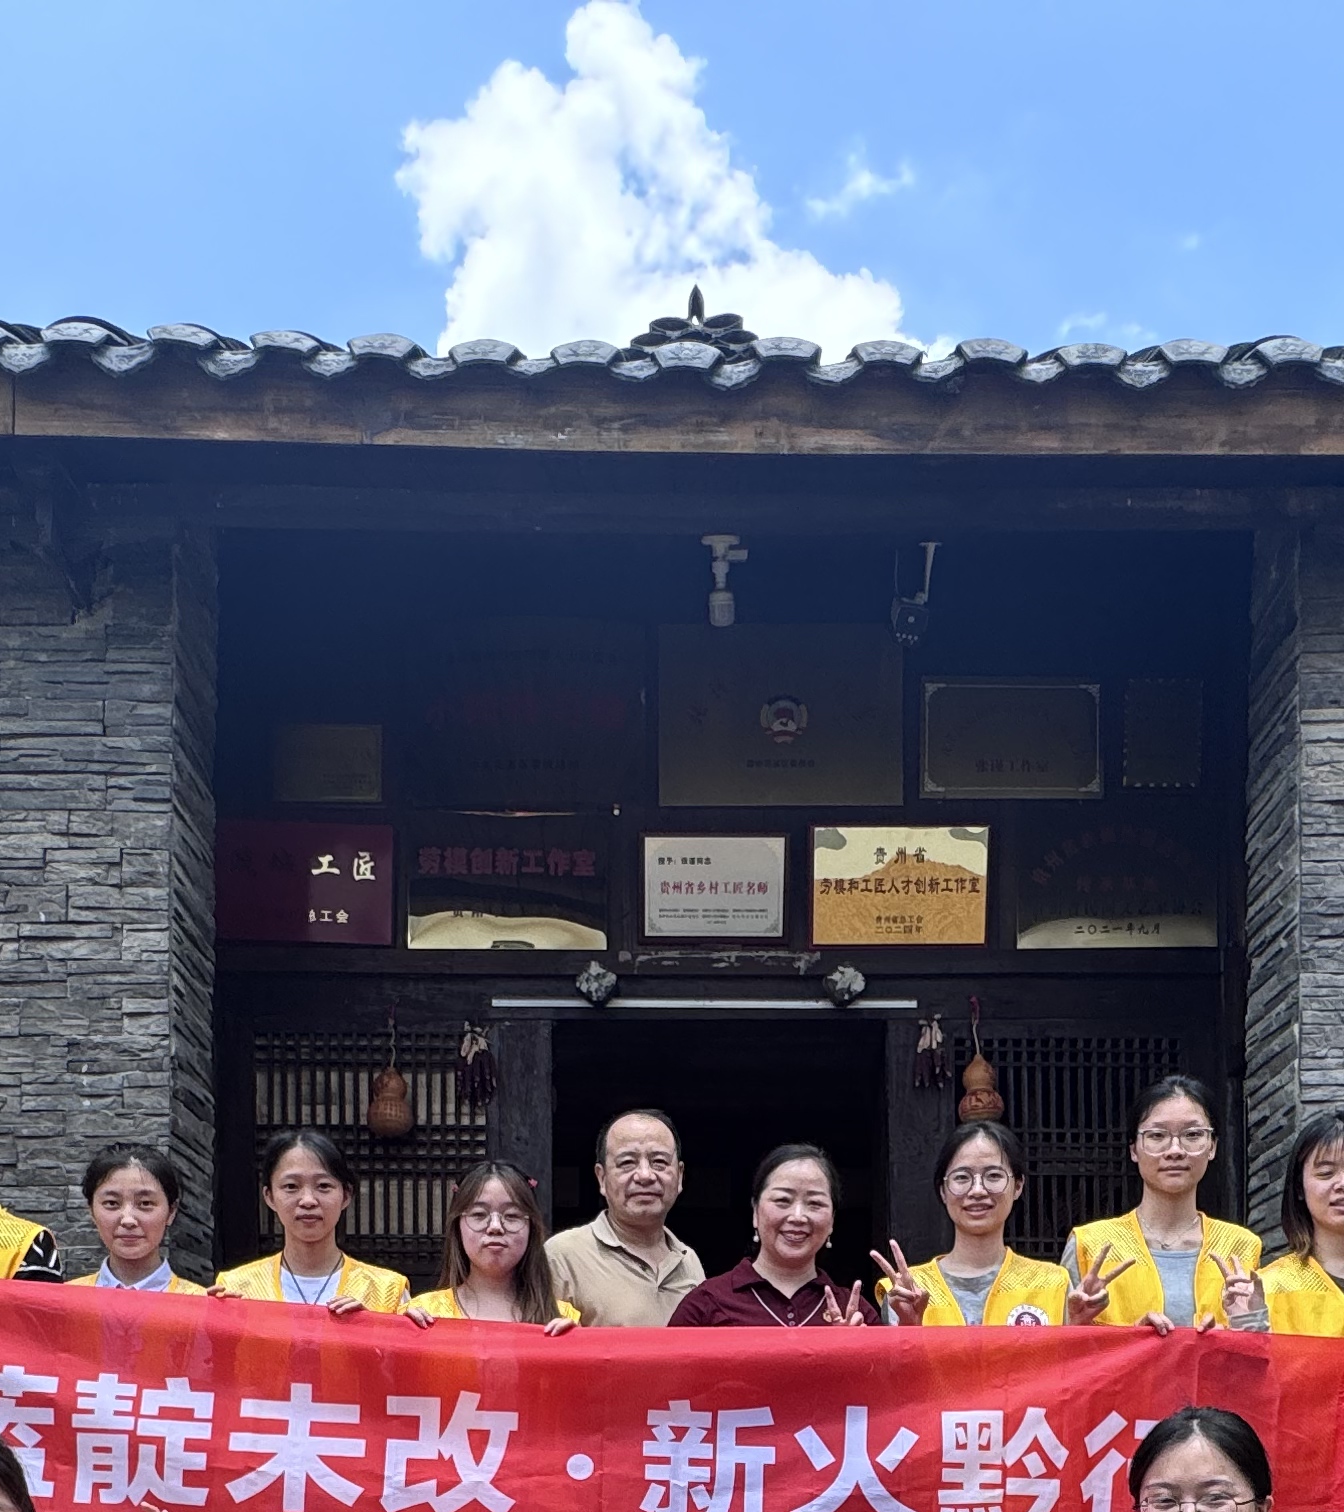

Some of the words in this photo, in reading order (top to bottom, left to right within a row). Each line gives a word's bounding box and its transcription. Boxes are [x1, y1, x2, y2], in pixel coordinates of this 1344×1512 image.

[418, 847, 596, 876] 劳模创新工作室
[874, 846, 927, 865] 贵州省
[660, 880, 768, 896] 贵州省乡村工匠名师
[819, 877, 981, 895] 劳模和工匠人才创新工作室
